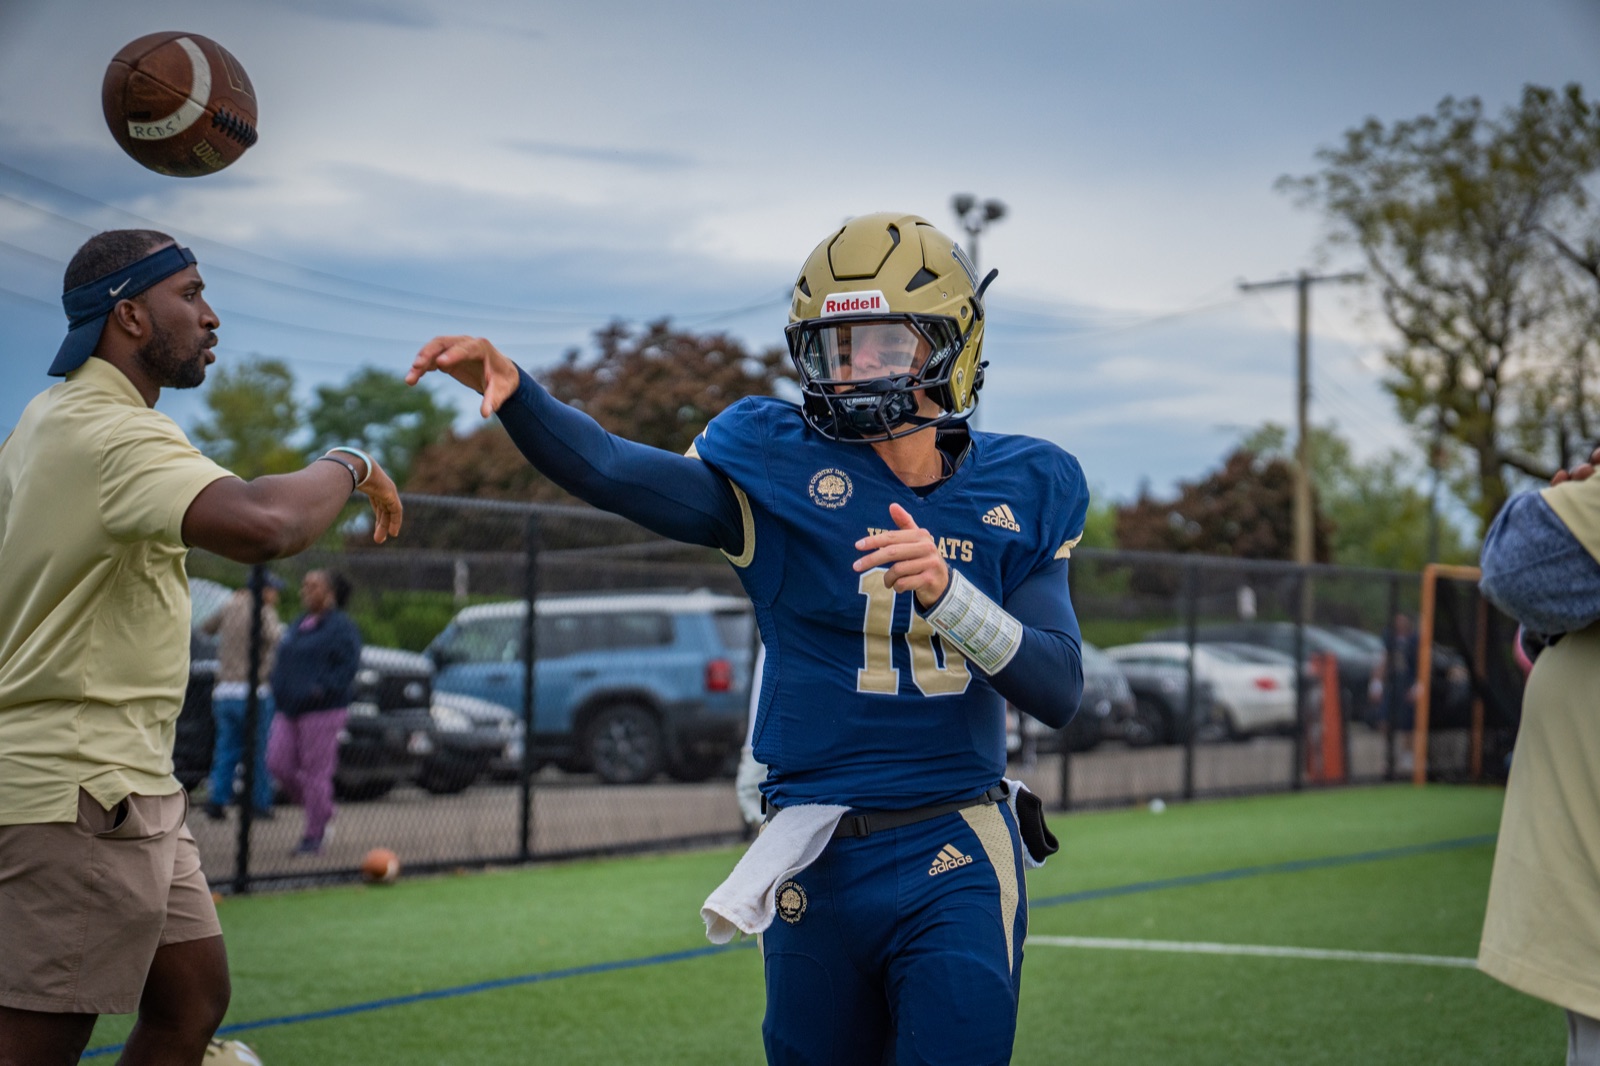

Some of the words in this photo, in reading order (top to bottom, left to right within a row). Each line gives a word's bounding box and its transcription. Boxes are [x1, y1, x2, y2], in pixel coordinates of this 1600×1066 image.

[134, 121, 176, 137] RCDS
[826, 296, 880, 313] Riddell
[982, 514, 1021, 533] adidas
[928, 855, 973, 876] adidas
